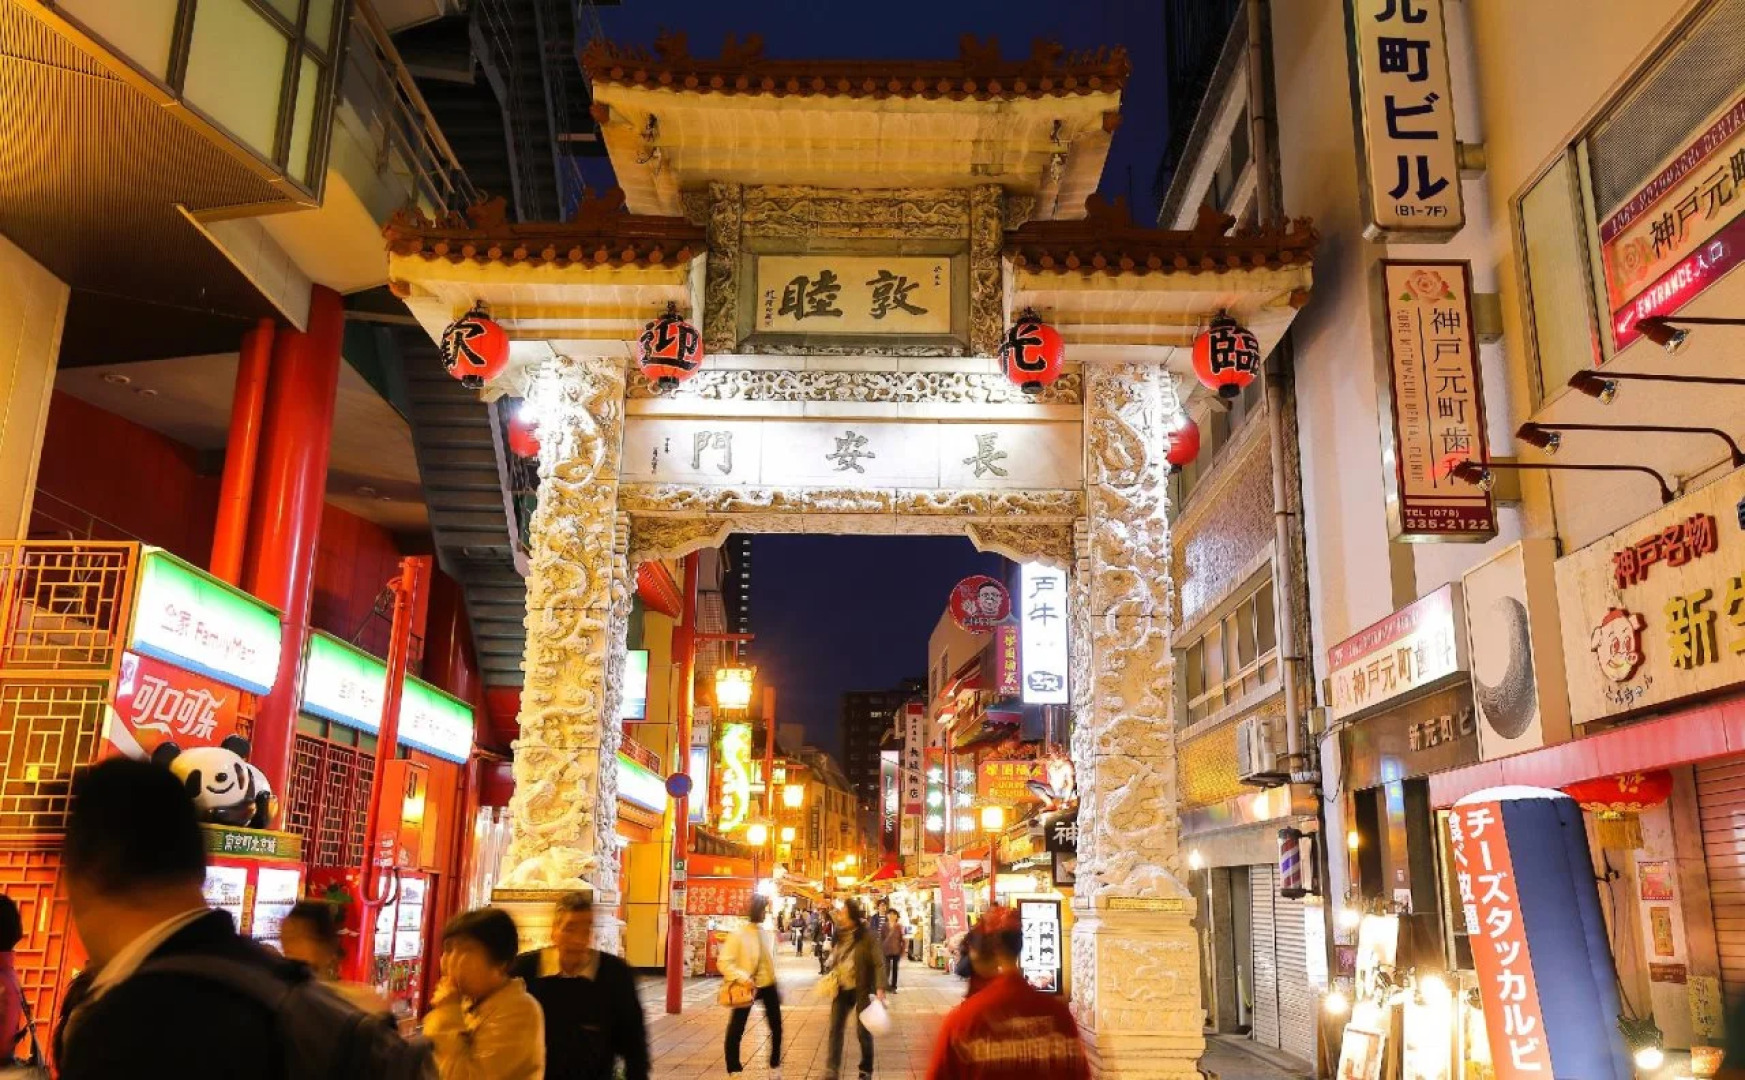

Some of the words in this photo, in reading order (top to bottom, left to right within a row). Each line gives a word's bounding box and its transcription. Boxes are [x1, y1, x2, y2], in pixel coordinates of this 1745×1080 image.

[1395, 204, 1449, 218] (B1-7F)
[1636, 263, 1694, 320] ENTRANCE
[1404, 507, 1426, 517] TEL
[1429, 507, 1460, 518] (078)
[1406, 518, 1489, 530] 335-2122
[1612, 512, 1718, 590] 神戸名物
[1466, 807, 1542, 1071] チーズタッカルビ
